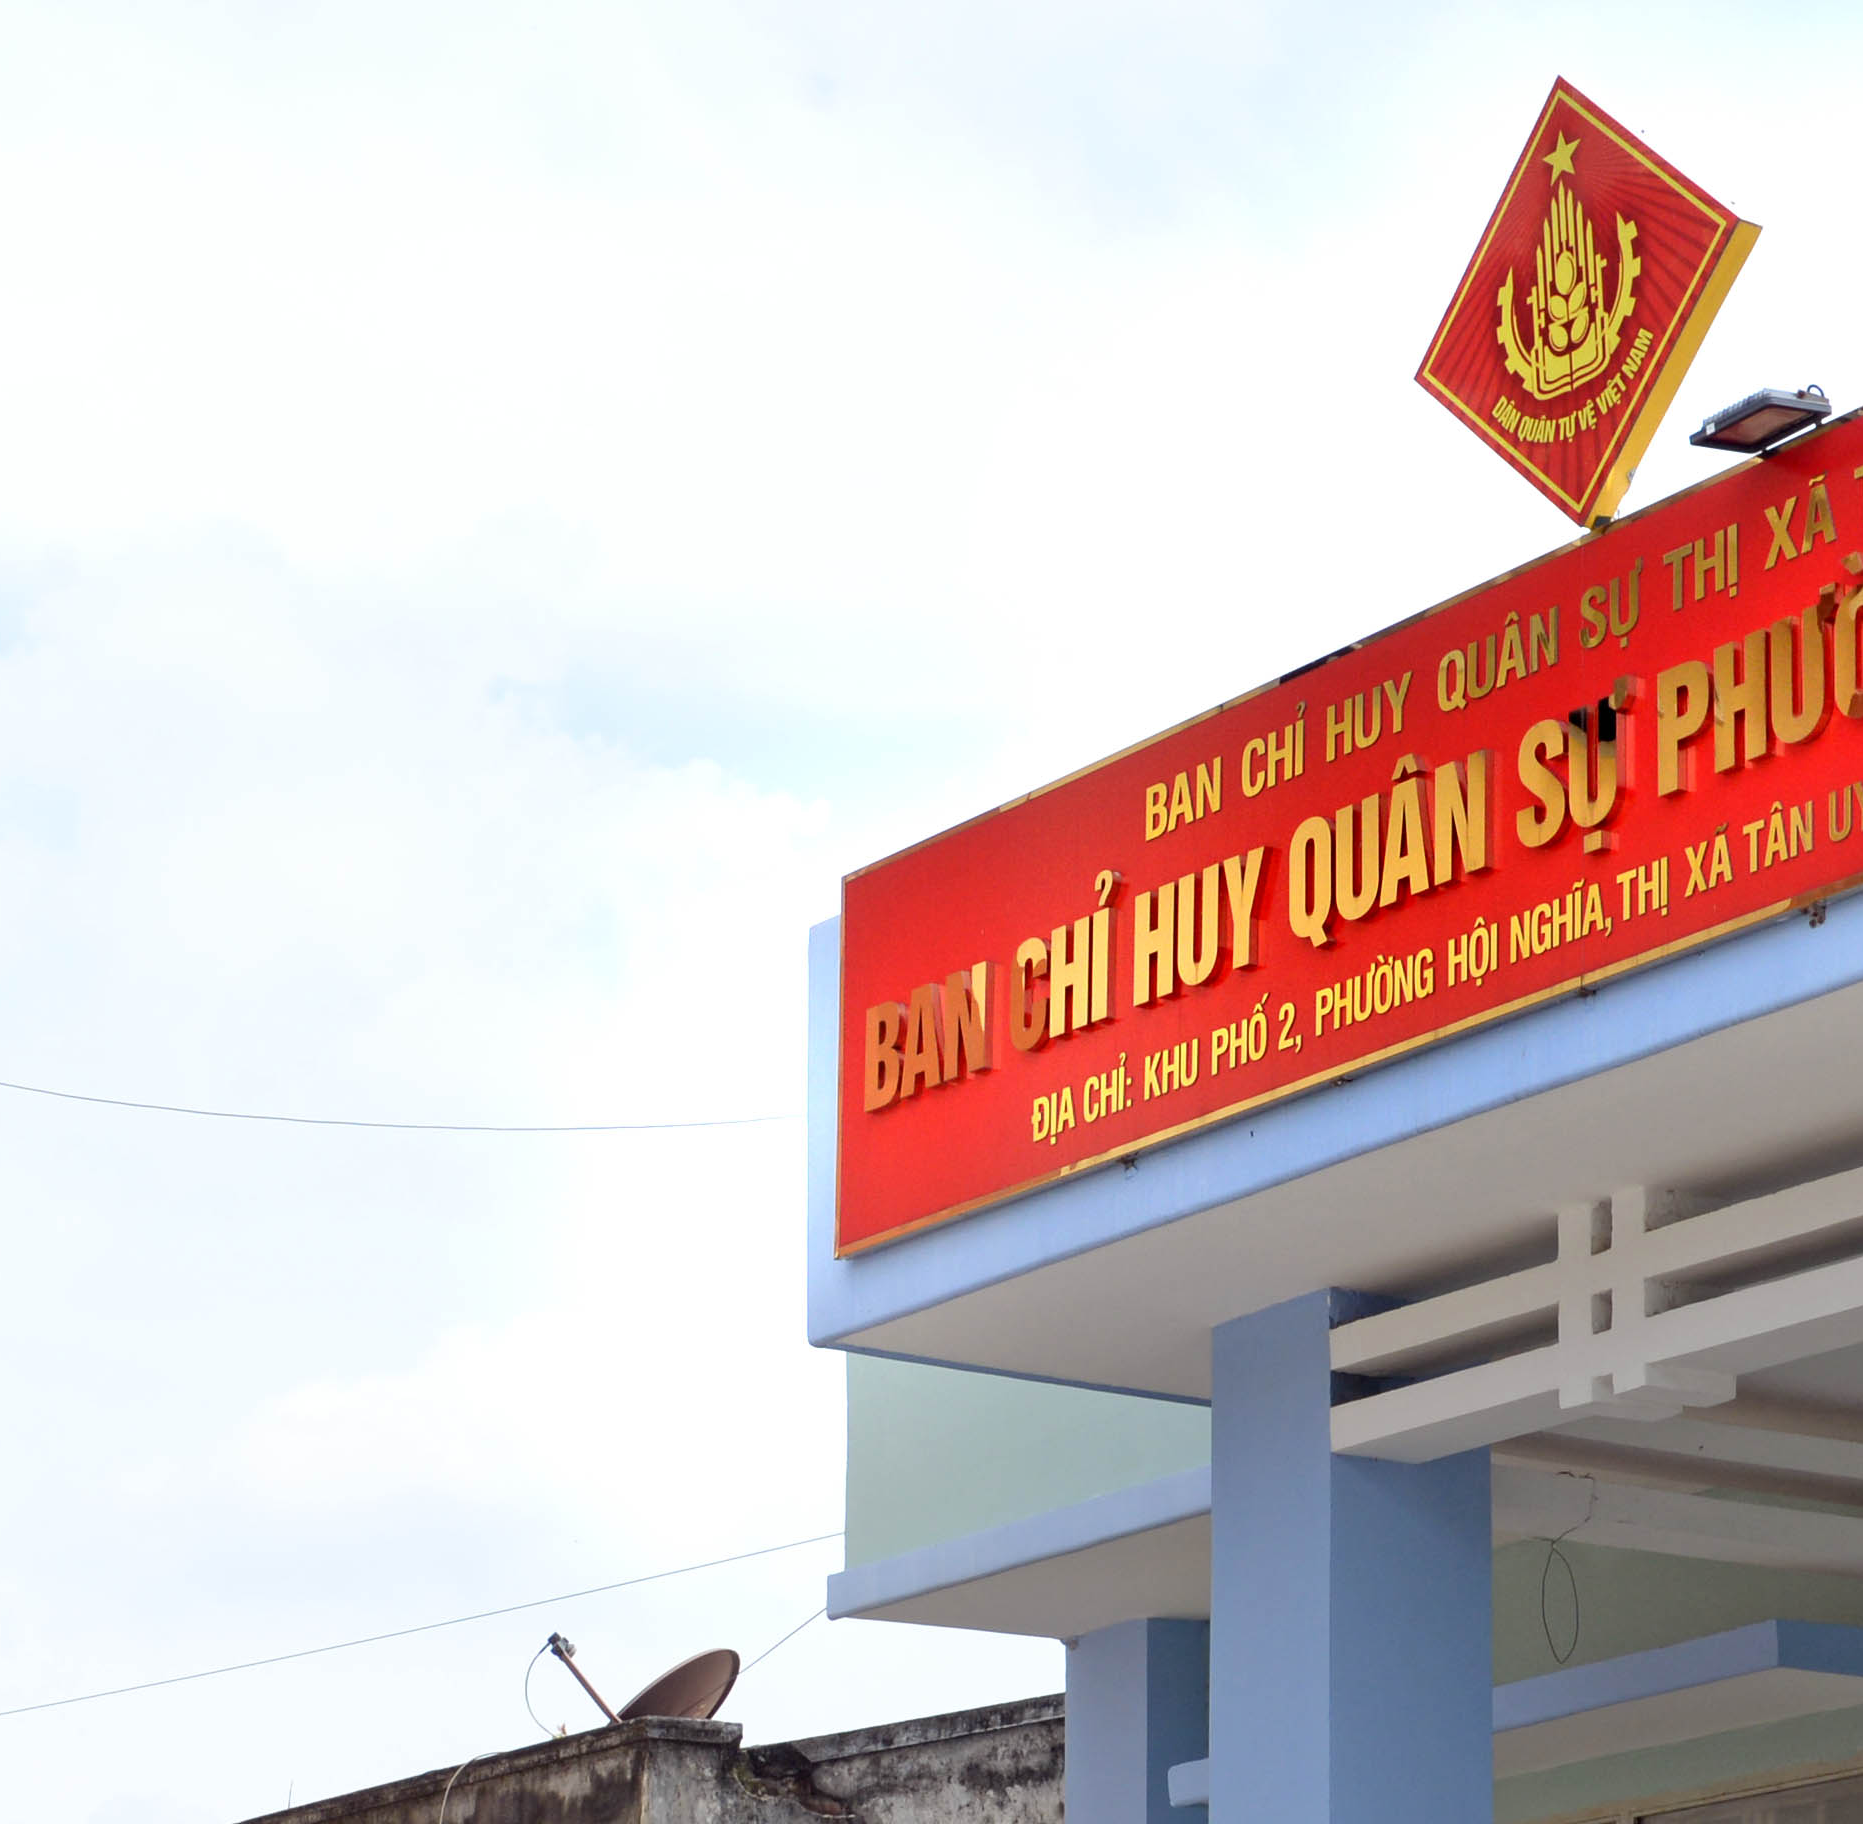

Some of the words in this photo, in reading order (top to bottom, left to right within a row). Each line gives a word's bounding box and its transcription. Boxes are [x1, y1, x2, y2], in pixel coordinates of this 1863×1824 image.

[1492, 395, 1521, 433] DÂN
[1517, 415, 1556, 443] QUÂN
[1558, 411, 1577, 443] TỰ
[1578, 399, 1597, 431] VỆ
[1595, 373, 1627, 415] VIỆT
[1621, 328, 1654, 379] NAM
[1145, 756, 1221, 842] BAN
[1241, 702, 1306, 798] CHỈ
[1325, 672, 1413, 762] HUY
[1438, 606, 1559, 712] QUÂN
[1579, 556, 1642, 649] SỰ
[1663, 522, 1738, 611] THỊ
[1764, 474, 1837, 571] XÃ
[865, 960, 993, 1112] BAN
[1010, 870, 1124, 1052] CHỈ
[1133, 846, 1271, 1007] HUY
[1288, 748, 1494, 948] QUÂN
[1516, 674, 1635, 854] SỰ
[1032, 1086, 1076, 1145] ĐỊA
[1084, 1052, 1133, 1123] CHỈ:
[1144, 1038, 1199, 1100] KHU
[1211, 992, 1270, 1077] PHỐ
[1278, 1002, 1302, 1055] 2,
[1316, 948, 1434, 1037] PHƯỜNG
[1448, 917, 1498, 987] HỘI
[1510, 878, 1612, 964] NGHĨA,
[1616, 856, 1669, 917] THỊ
[1684, 822, 1733, 898] XÃ
[1743, 800, 1814, 873] TÂN
